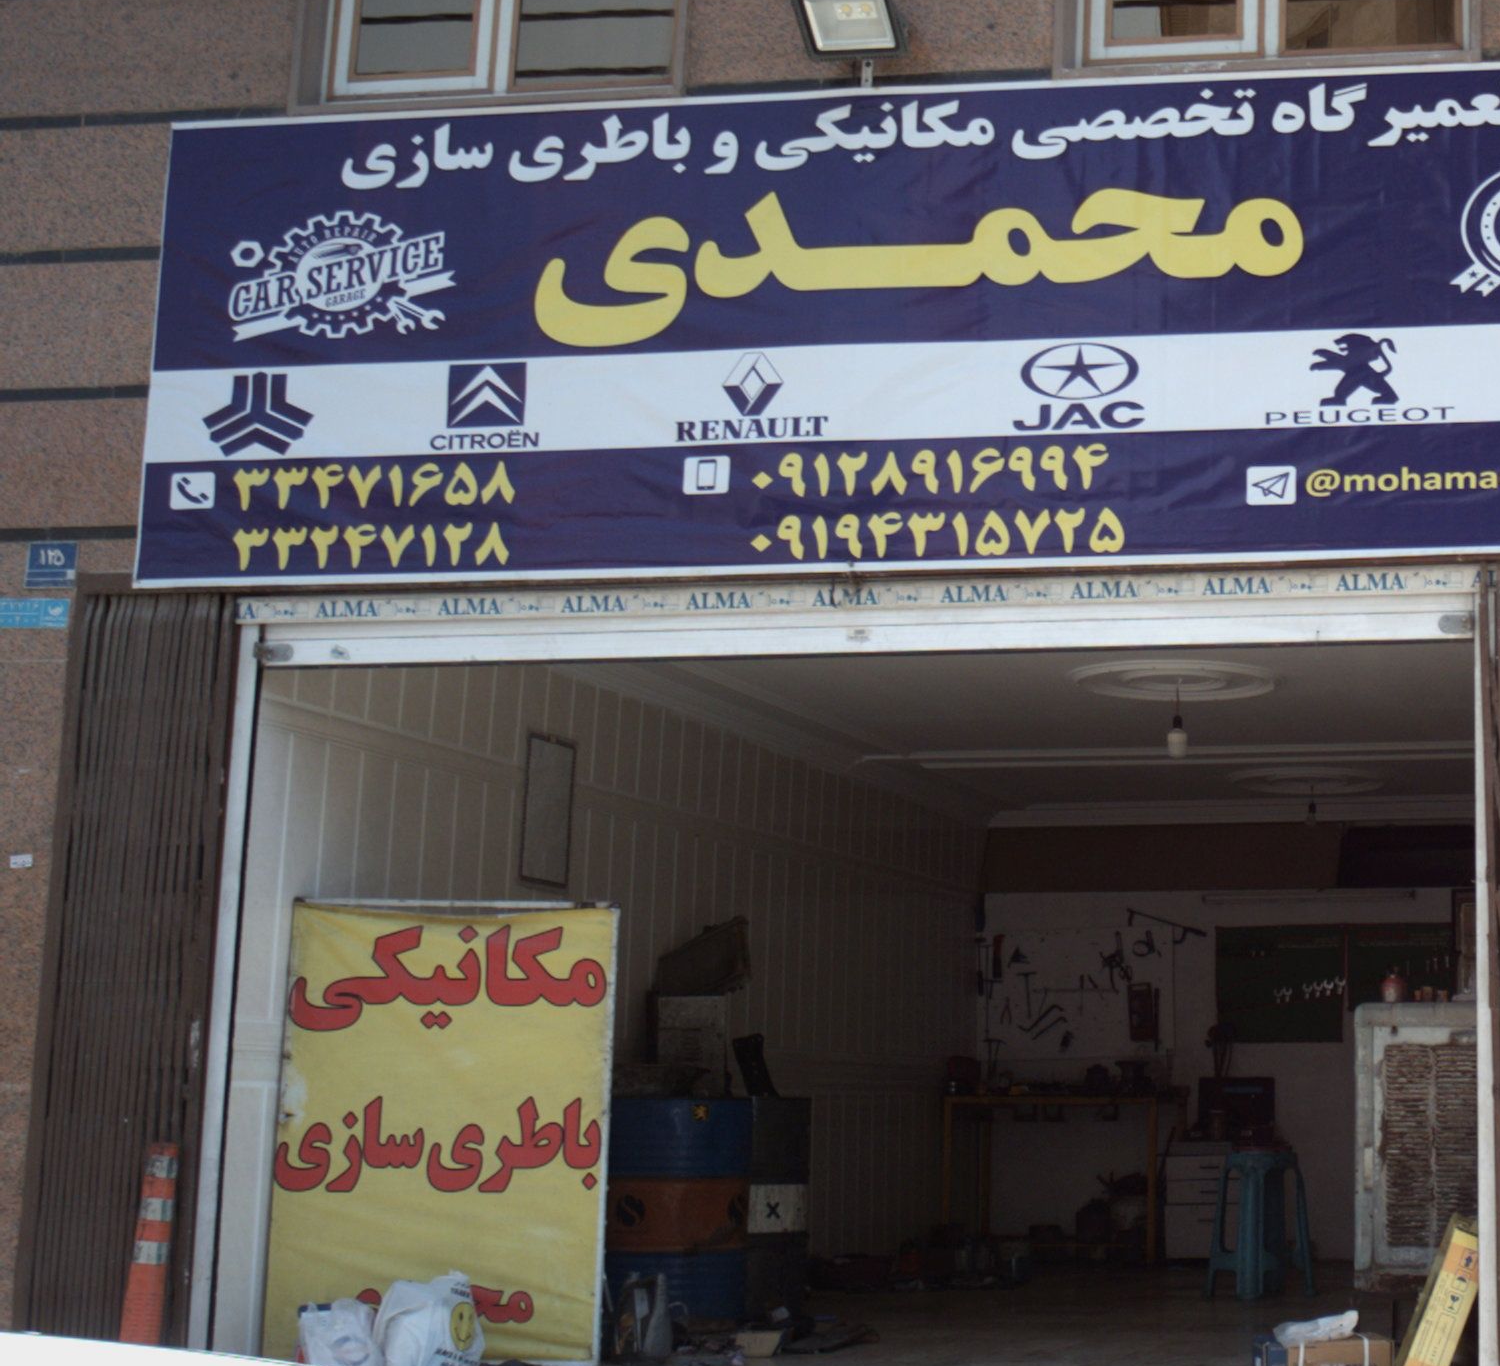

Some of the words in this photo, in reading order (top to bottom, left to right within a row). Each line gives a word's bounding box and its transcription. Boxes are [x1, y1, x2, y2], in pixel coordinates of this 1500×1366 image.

[508, 113, 691, 183] باطری
[753, 99, 996, 172] مکانیکی
[1011, 87, 1257, 160] تخصصی
[340, 122, 494, 190] سازی
[703, 129, 739, 175] و
[231, 273, 300, 320] CAR
[306, 238, 442, 300] SERVICE
[533, 186, 1308, 348] محمدی
[324, 288, 367, 308] GARAGE
[429, 430, 540, 452] CITROËN
[674, 415, 830, 443] RENAULT
[1012, 400, 1147, 432] JAC
[1264, 405, 1457, 426] PEUGEOT
[232, 460, 516, 512] ۳۳۴۷۱۶۵۸
[751, 442, 1110, 498] ۰۹۱۲۸۹۱۶۹۹۴
[232, 521, 510, 571] ۳۳۲۴۷۱۲۸
[749, 506, 1126, 561] ۰۹۱۹۴۳۱۵۷۲۵
[316, 600, 378, 618] ALMA
[438, 598, 502, 615] ALMA
[561, 595, 625, 614] ALMA
[686, 592, 751, 610] ALMA
[941, 585, 1006, 604] ALMA
[1070, 581, 1138, 599] ALMA
[1201, 578, 1270, 596] ALMA
[1335, 573, 1403, 592] ALMA
[288, 924, 608, 1032] مکانیکی
[273, 1095, 425, 1193] سازی
[426, 1095, 601, 1193] باطری
